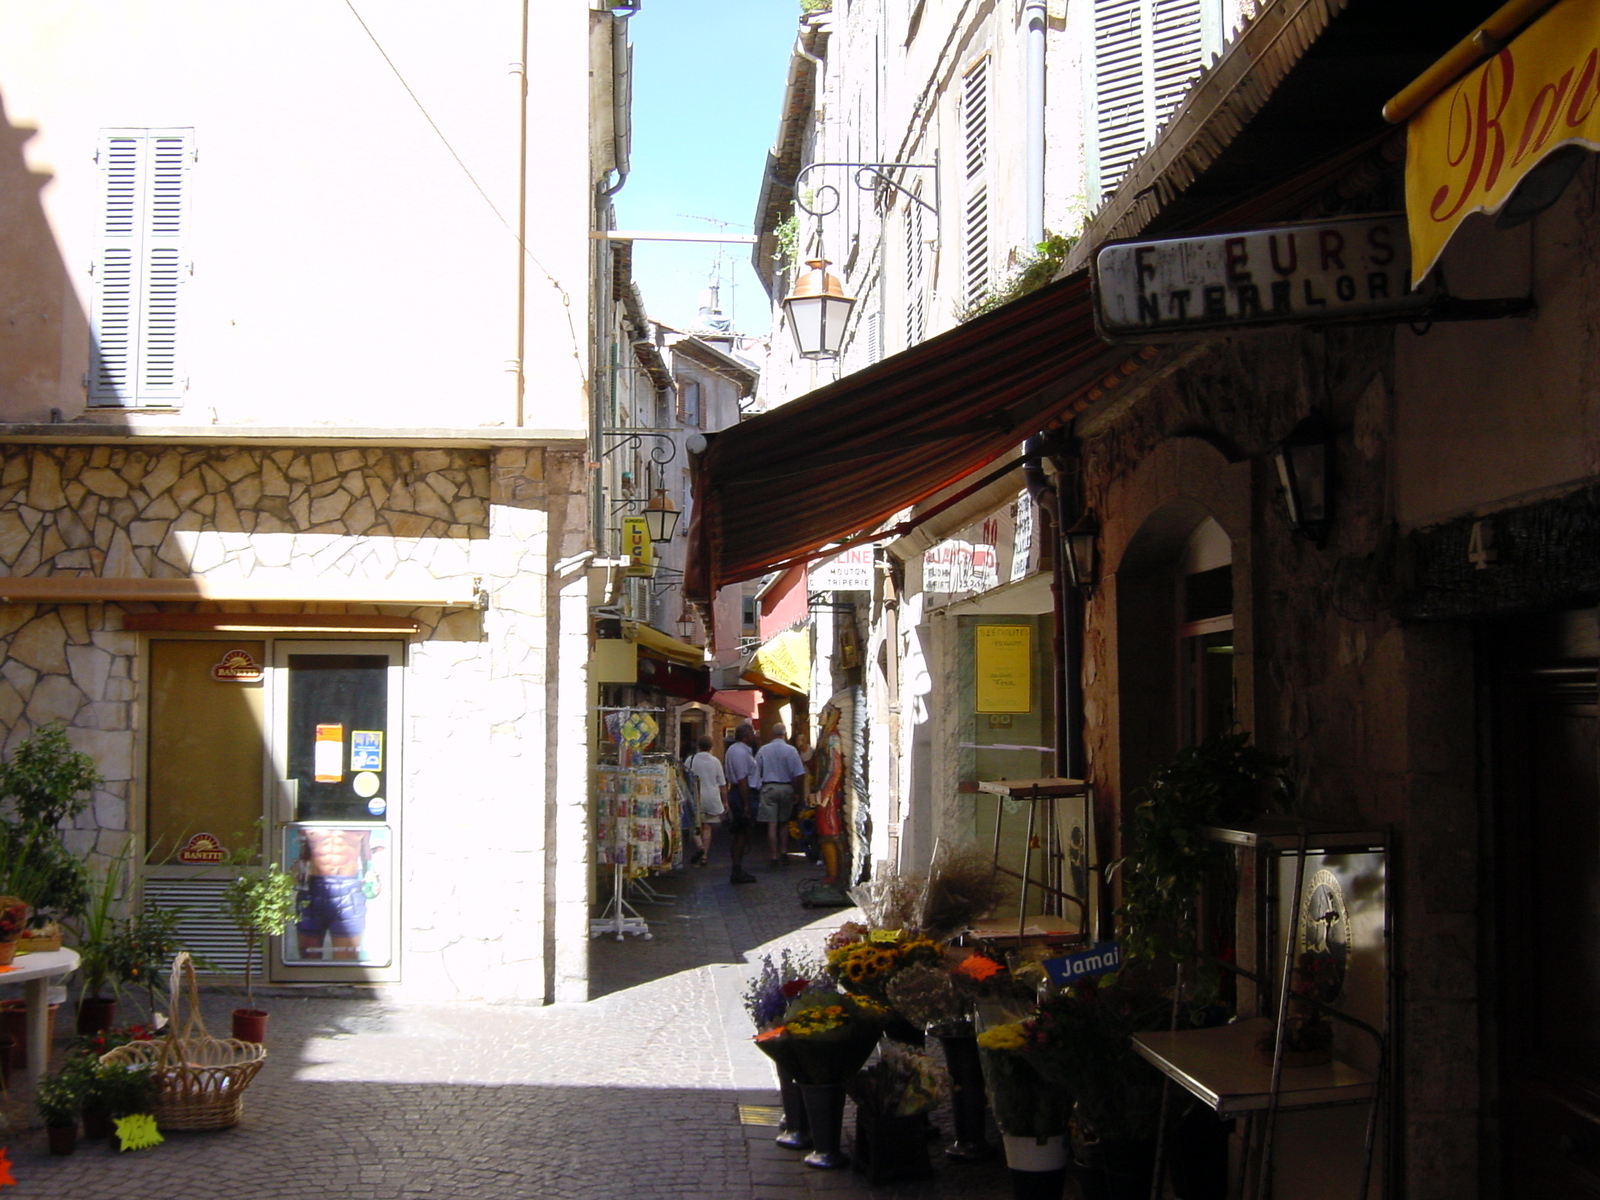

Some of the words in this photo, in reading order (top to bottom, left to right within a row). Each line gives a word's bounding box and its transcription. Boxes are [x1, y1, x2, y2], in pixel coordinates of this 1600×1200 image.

[1135, 225, 1395, 292] FEURS
[1117, 270, 1423, 324] NTERFLOR
[834, 550, 871, 564] LINE
[829, 568, 867, 576] MOUTON
[827, 579, 869, 587] TRIPERIE
[218, 668, 260, 677] BANETTE
[184, 851, 224, 861] BANETTE
[1061, 946, 1119, 978] Jamai
